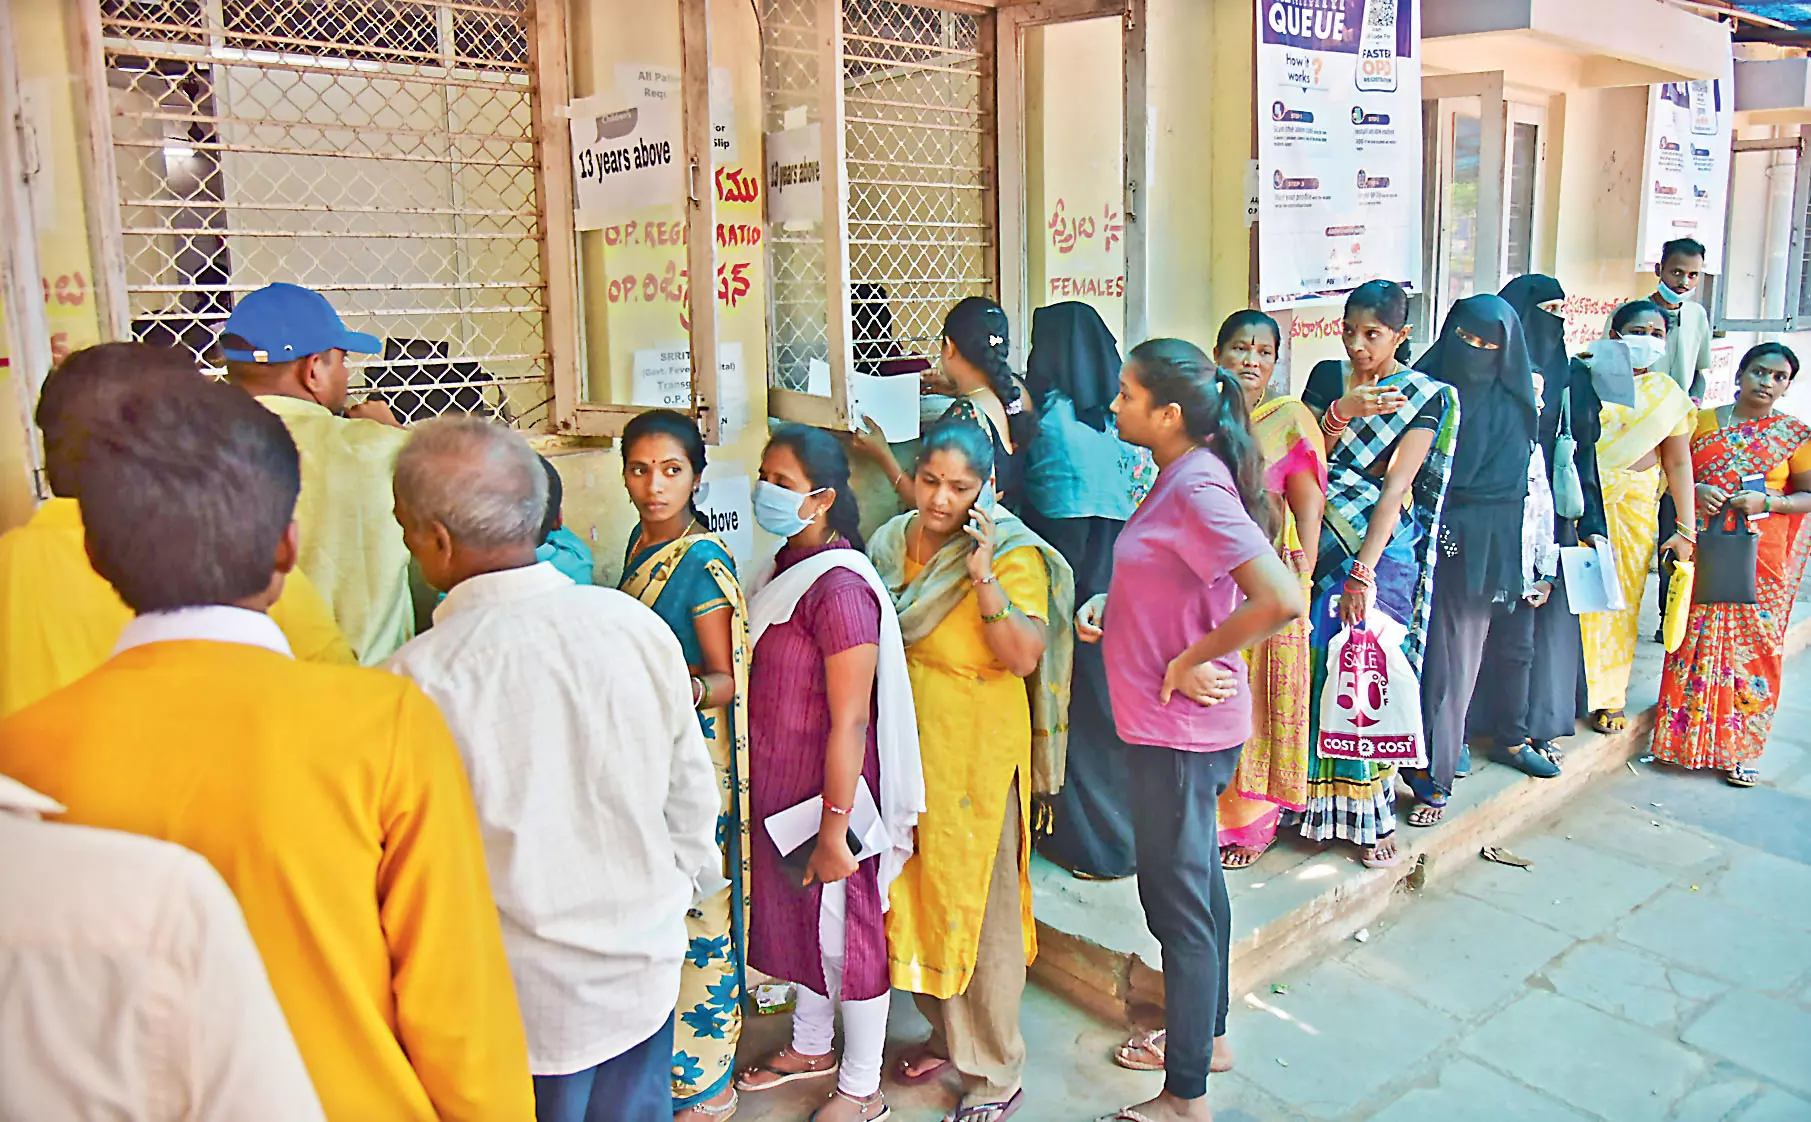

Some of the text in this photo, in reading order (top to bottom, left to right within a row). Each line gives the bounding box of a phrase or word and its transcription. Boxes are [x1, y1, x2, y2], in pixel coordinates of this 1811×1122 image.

[1268, 2, 1345, 40] QUEUE
[1286, 53, 1310, 68] How it
[638, 71, 652, 81] All
[1288, 71, 1311, 84] works
[713, 123, 726, 132] or
[578, 137, 671, 184] 13 years above
[1050, 275, 1125, 298] FEMALES
[660, 351, 691, 362] SRRIT
[669, 367, 691, 376] Feve
[657, 381, 691, 391] Transg
[709, 508, 738, 533] bove
[1344, 651, 1378, 669] SALE
[1323, 738, 1412, 753] COST 2 COST
